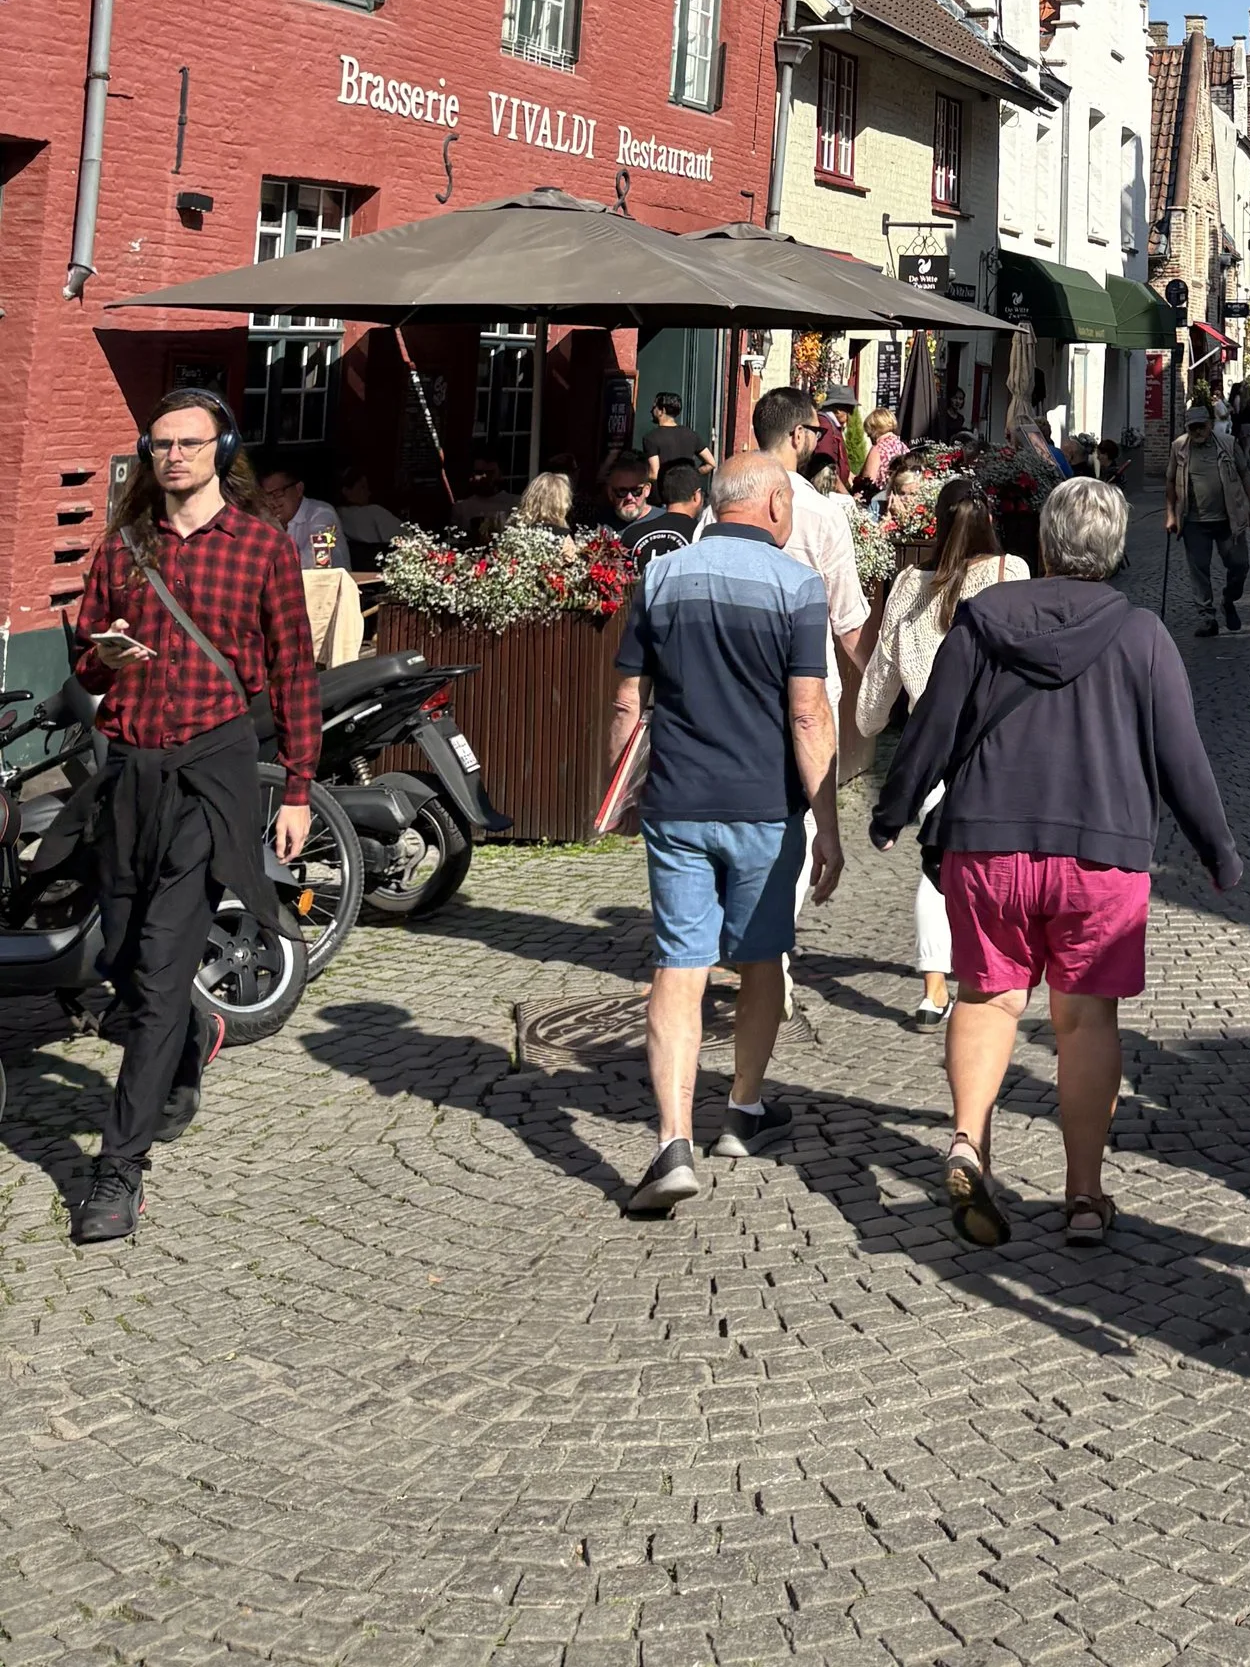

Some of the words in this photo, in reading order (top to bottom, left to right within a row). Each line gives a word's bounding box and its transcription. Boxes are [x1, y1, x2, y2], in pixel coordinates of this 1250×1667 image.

[337, 54, 460, 128] Brasserie
[488, 91, 597, 159] VIVALDI
[616, 125, 713, 183] Restaurant
[908, 275, 919, 283] De
[919, 274, 938, 283] Witte
